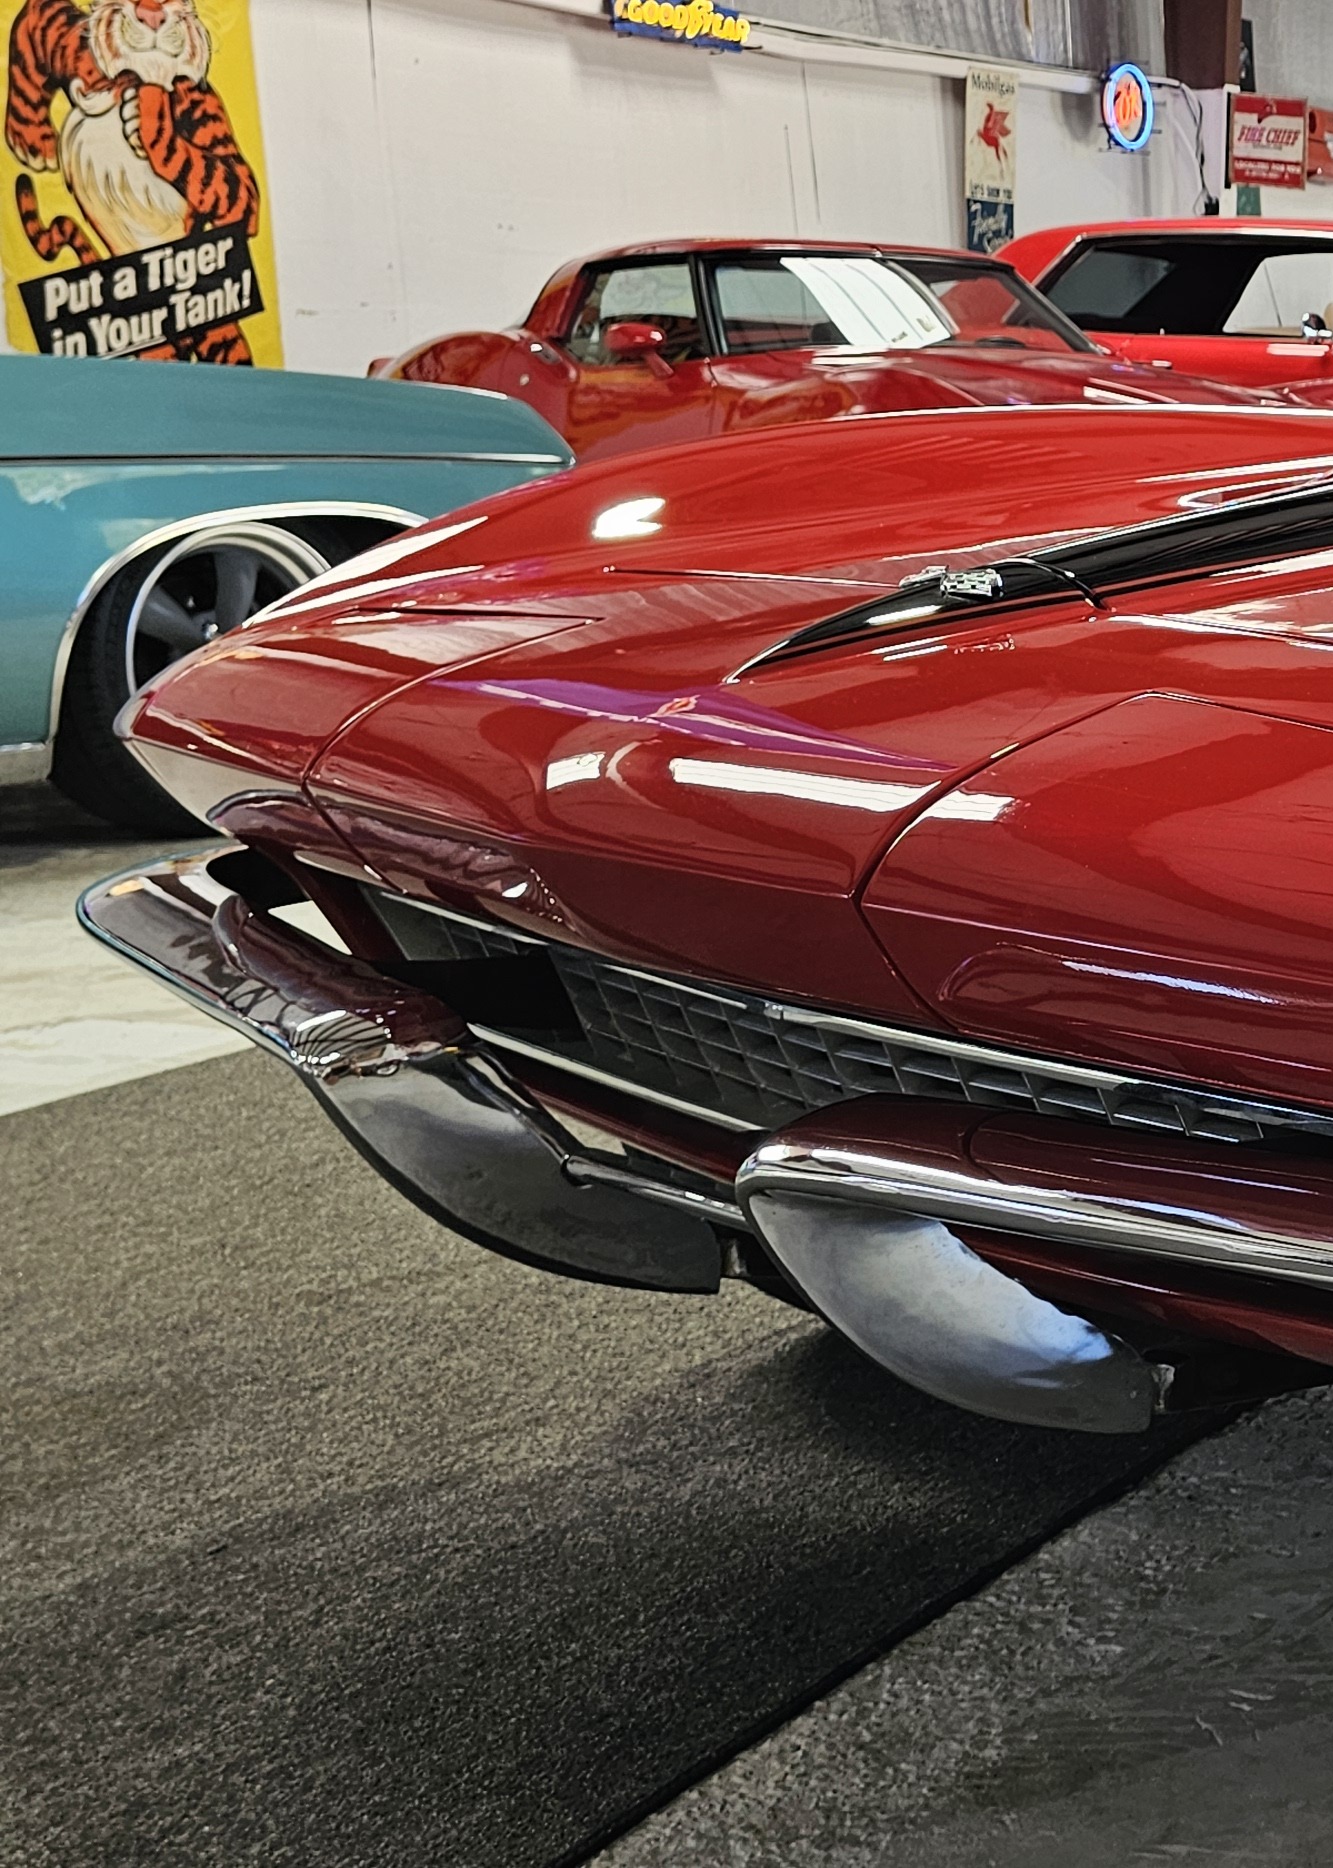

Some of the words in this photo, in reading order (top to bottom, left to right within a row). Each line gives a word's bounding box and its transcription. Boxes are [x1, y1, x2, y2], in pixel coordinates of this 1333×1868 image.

[628, 0, 751, 43] GOODYEAR
[971, 73, 1015, 95] Mobilgas
[44, 271, 104, 322] Put
[112, 265, 138, 301] a
[141, 236, 234, 292] Tiger
[50, 328, 88, 358] in
[88, 305, 169, 356] Your
[168, 268, 252, 333] Tank!
